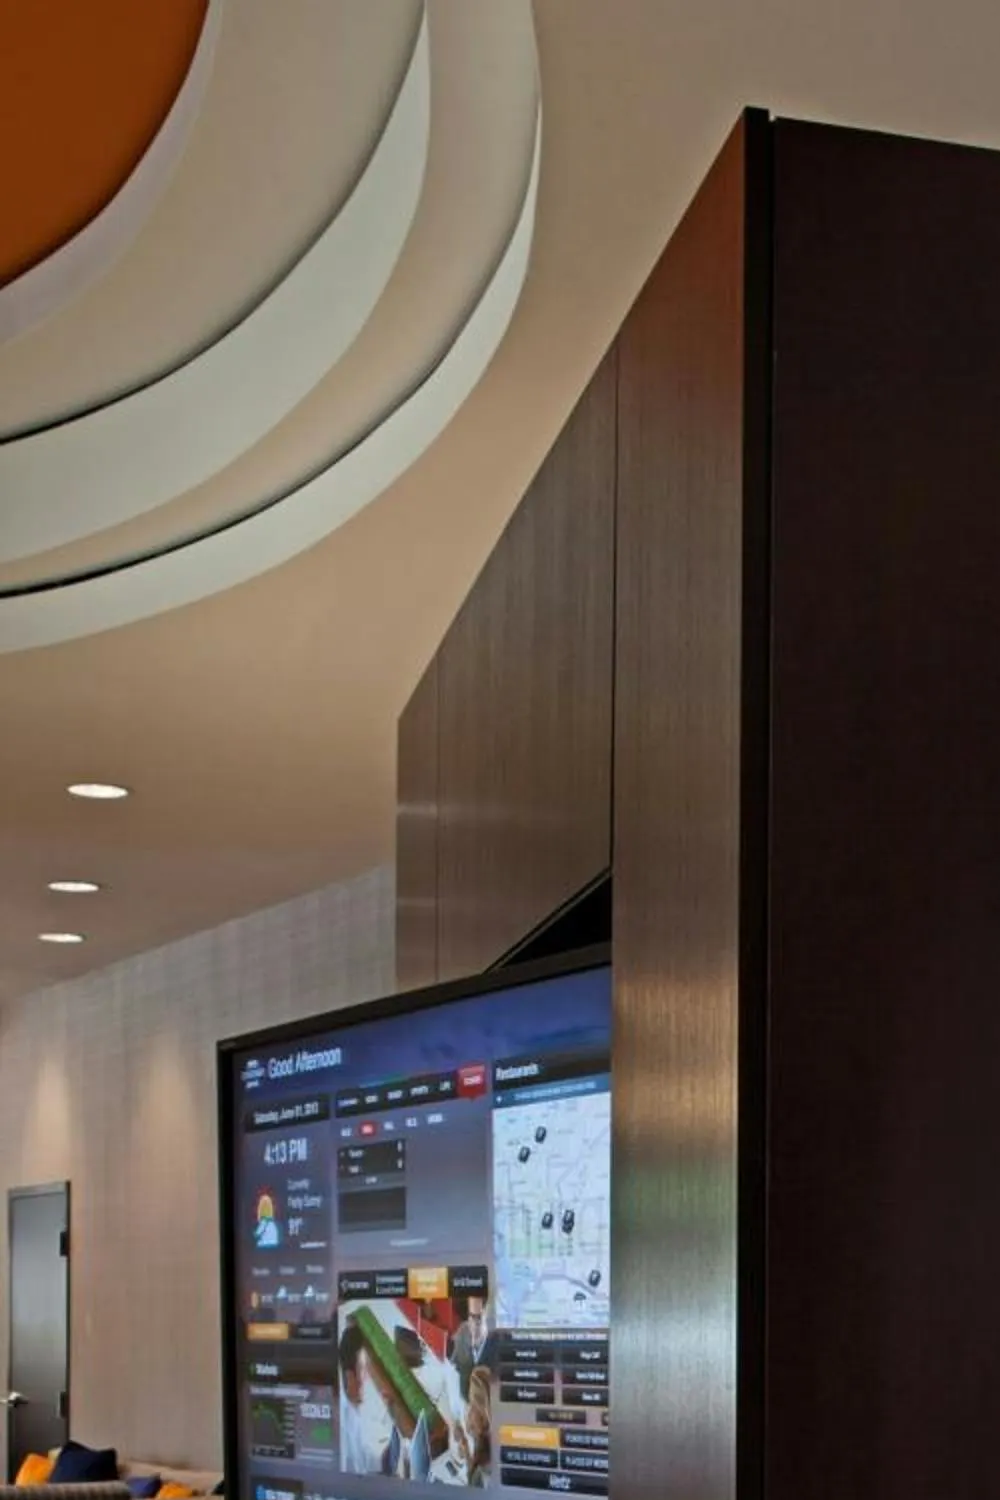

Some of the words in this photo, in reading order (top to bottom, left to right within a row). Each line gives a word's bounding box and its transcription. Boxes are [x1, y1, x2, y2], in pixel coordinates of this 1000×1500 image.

[268, 1055, 293, 1079] Good
[295, 1047, 342, 1073] Afternoon
[264, 1140, 287, 1165] 4:13
[289, 1137, 308, 1162] PM
